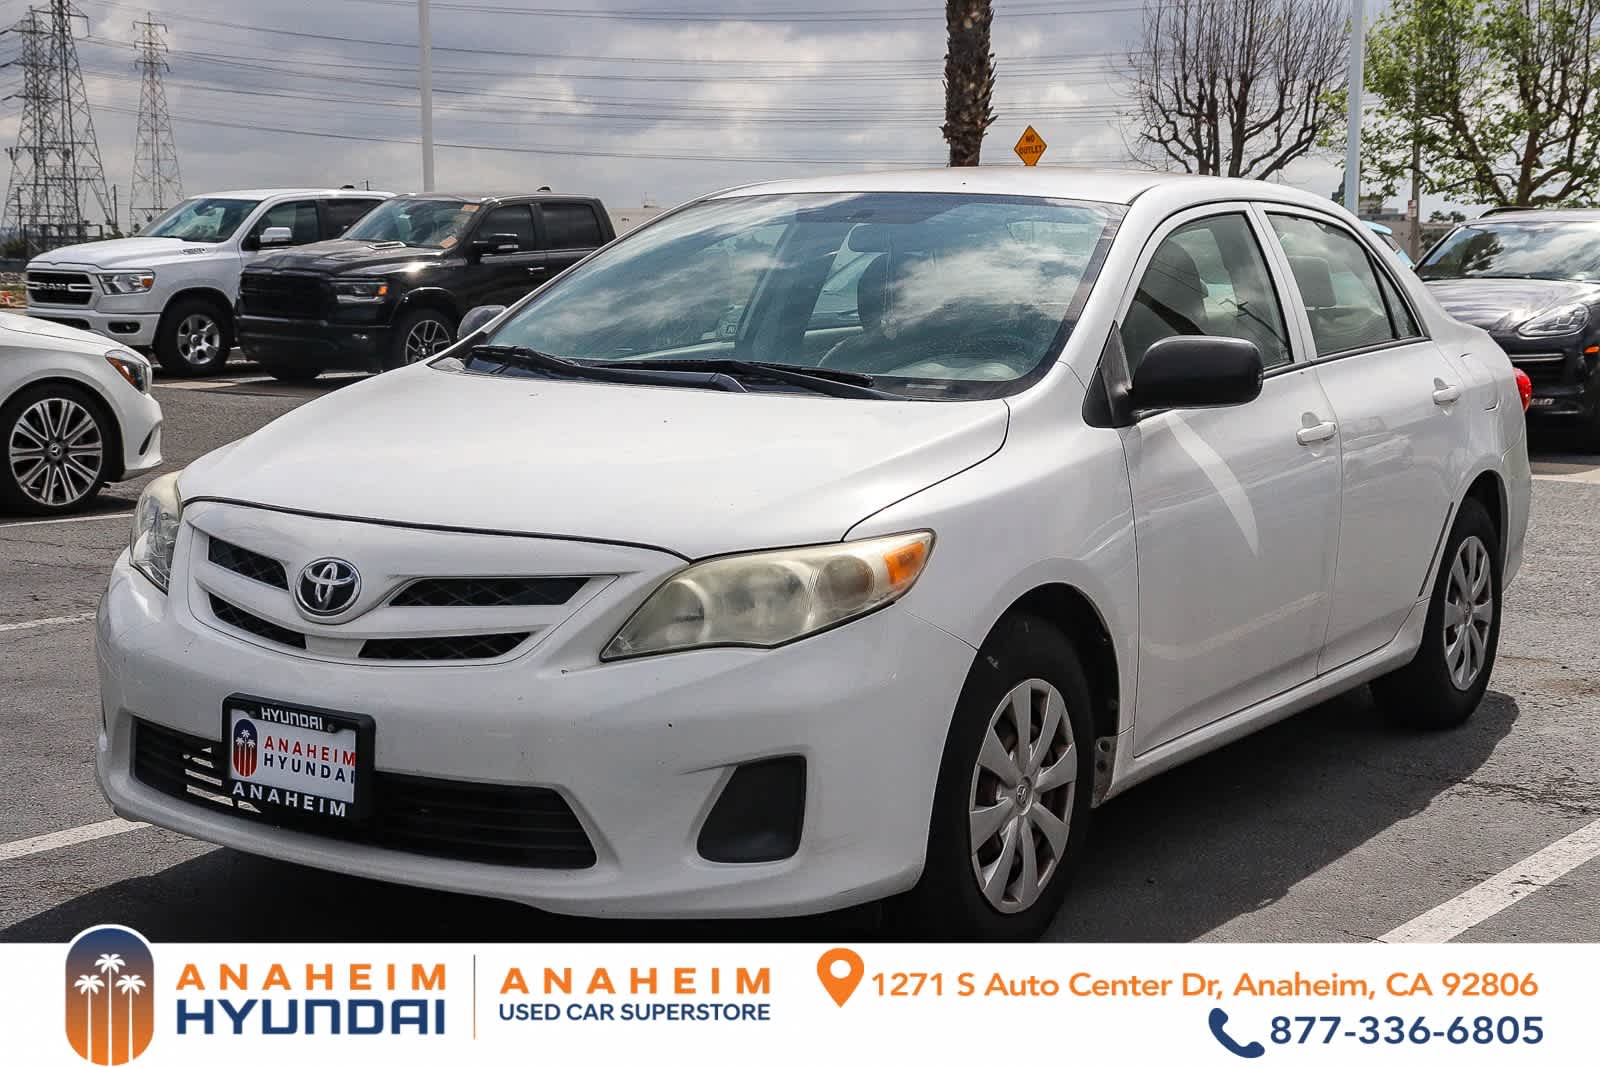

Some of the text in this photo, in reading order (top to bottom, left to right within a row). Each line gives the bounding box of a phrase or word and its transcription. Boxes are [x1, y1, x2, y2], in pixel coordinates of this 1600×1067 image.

[1019, 145, 1042, 154] OUTLET
[1025, 135, 1035, 143] NO
[39, 282, 67, 291] RAM
[261, 707, 323, 731] HYUNDAI
[264, 735, 357, 767] ANAHEIM
[264, 753, 355, 784] HYUNDAI
[232, 782, 347, 817] ANAHEIM
